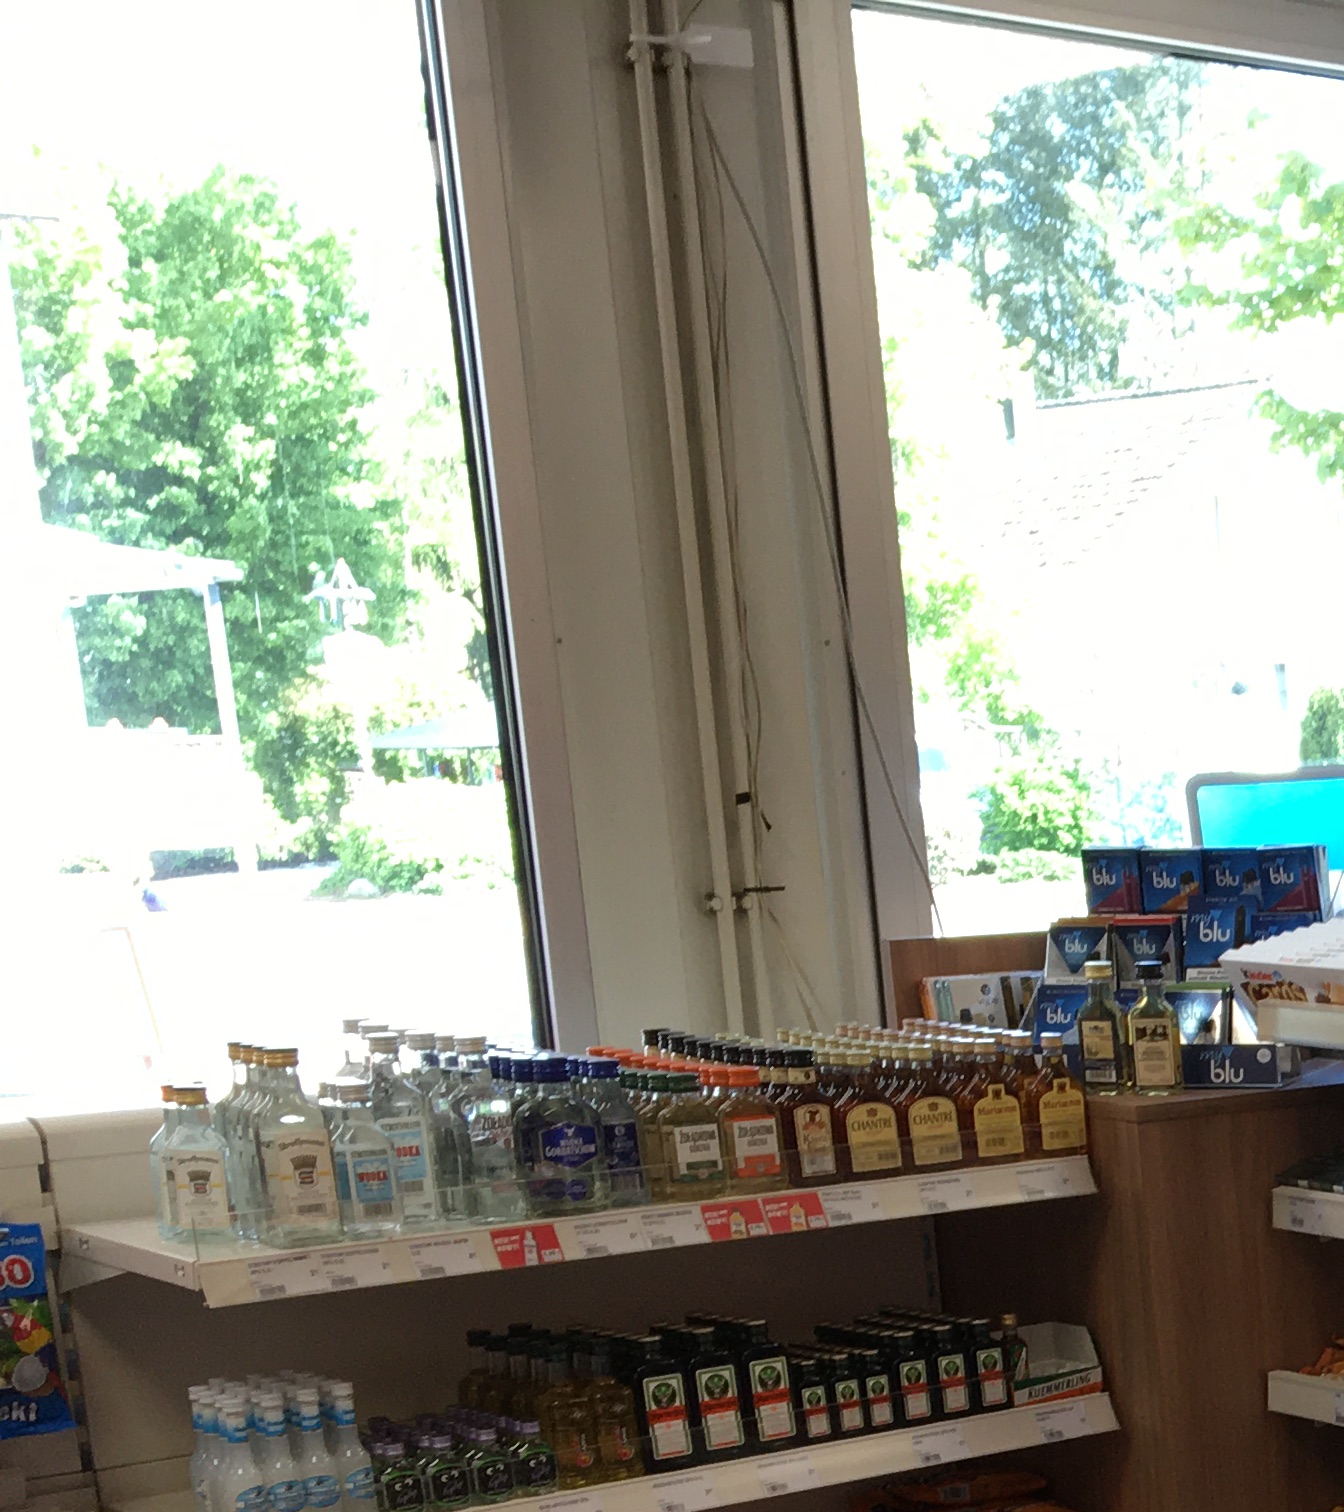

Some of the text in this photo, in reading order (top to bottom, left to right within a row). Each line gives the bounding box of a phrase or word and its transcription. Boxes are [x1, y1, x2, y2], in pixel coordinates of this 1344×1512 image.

[1092, 865, 1116, 885] blu
[1269, 864, 1294, 885] blu
[1199, 921, 1231, 943] blu
[1211, 1059, 1244, 1083] blu
[851, 1117, 894, 1133] CHANTRÉ
[913, 1111, 954, 1127] CHANTRÉ
